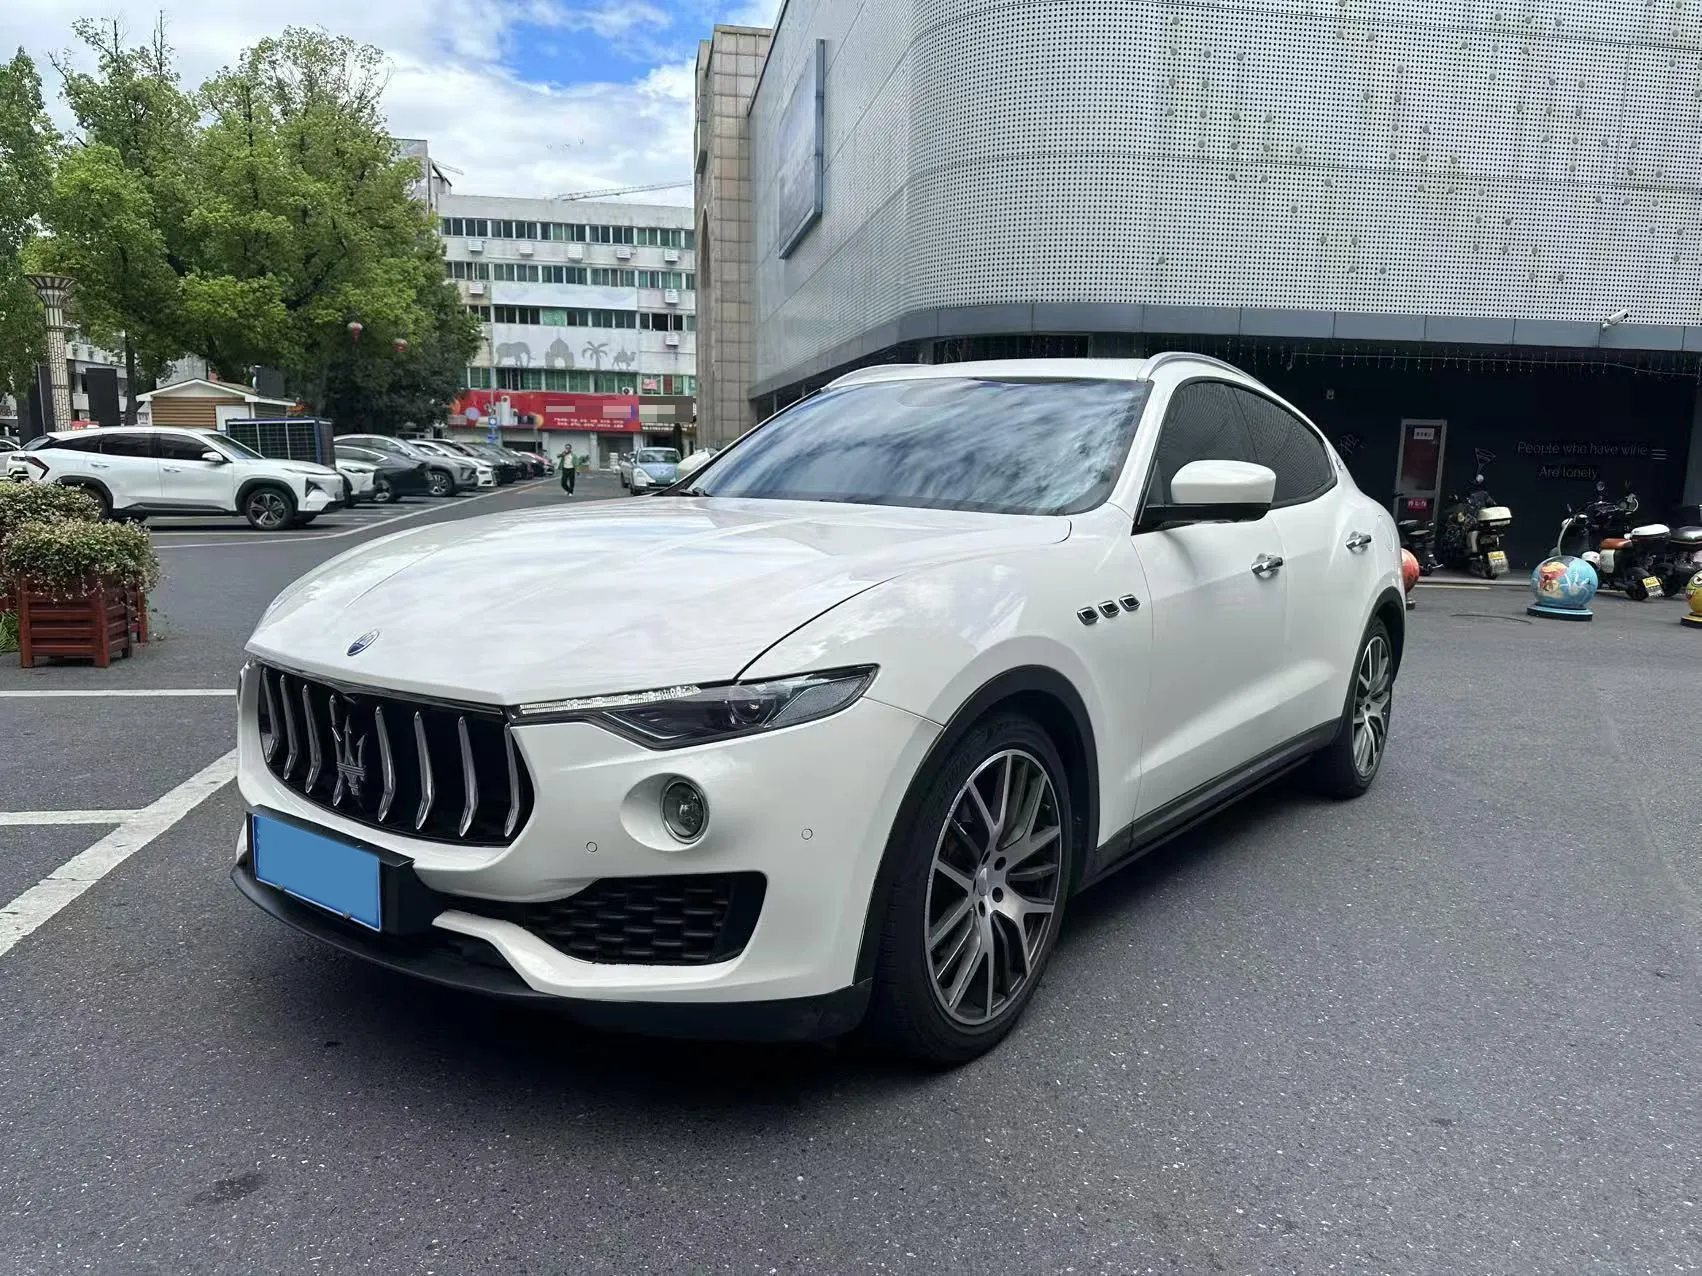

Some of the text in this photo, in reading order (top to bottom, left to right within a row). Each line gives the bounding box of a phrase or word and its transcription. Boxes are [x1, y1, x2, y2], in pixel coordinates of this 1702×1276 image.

[1517, 441, 1649, 456] People who have wine
[1538, 465, 1599, 480] Are lonely
